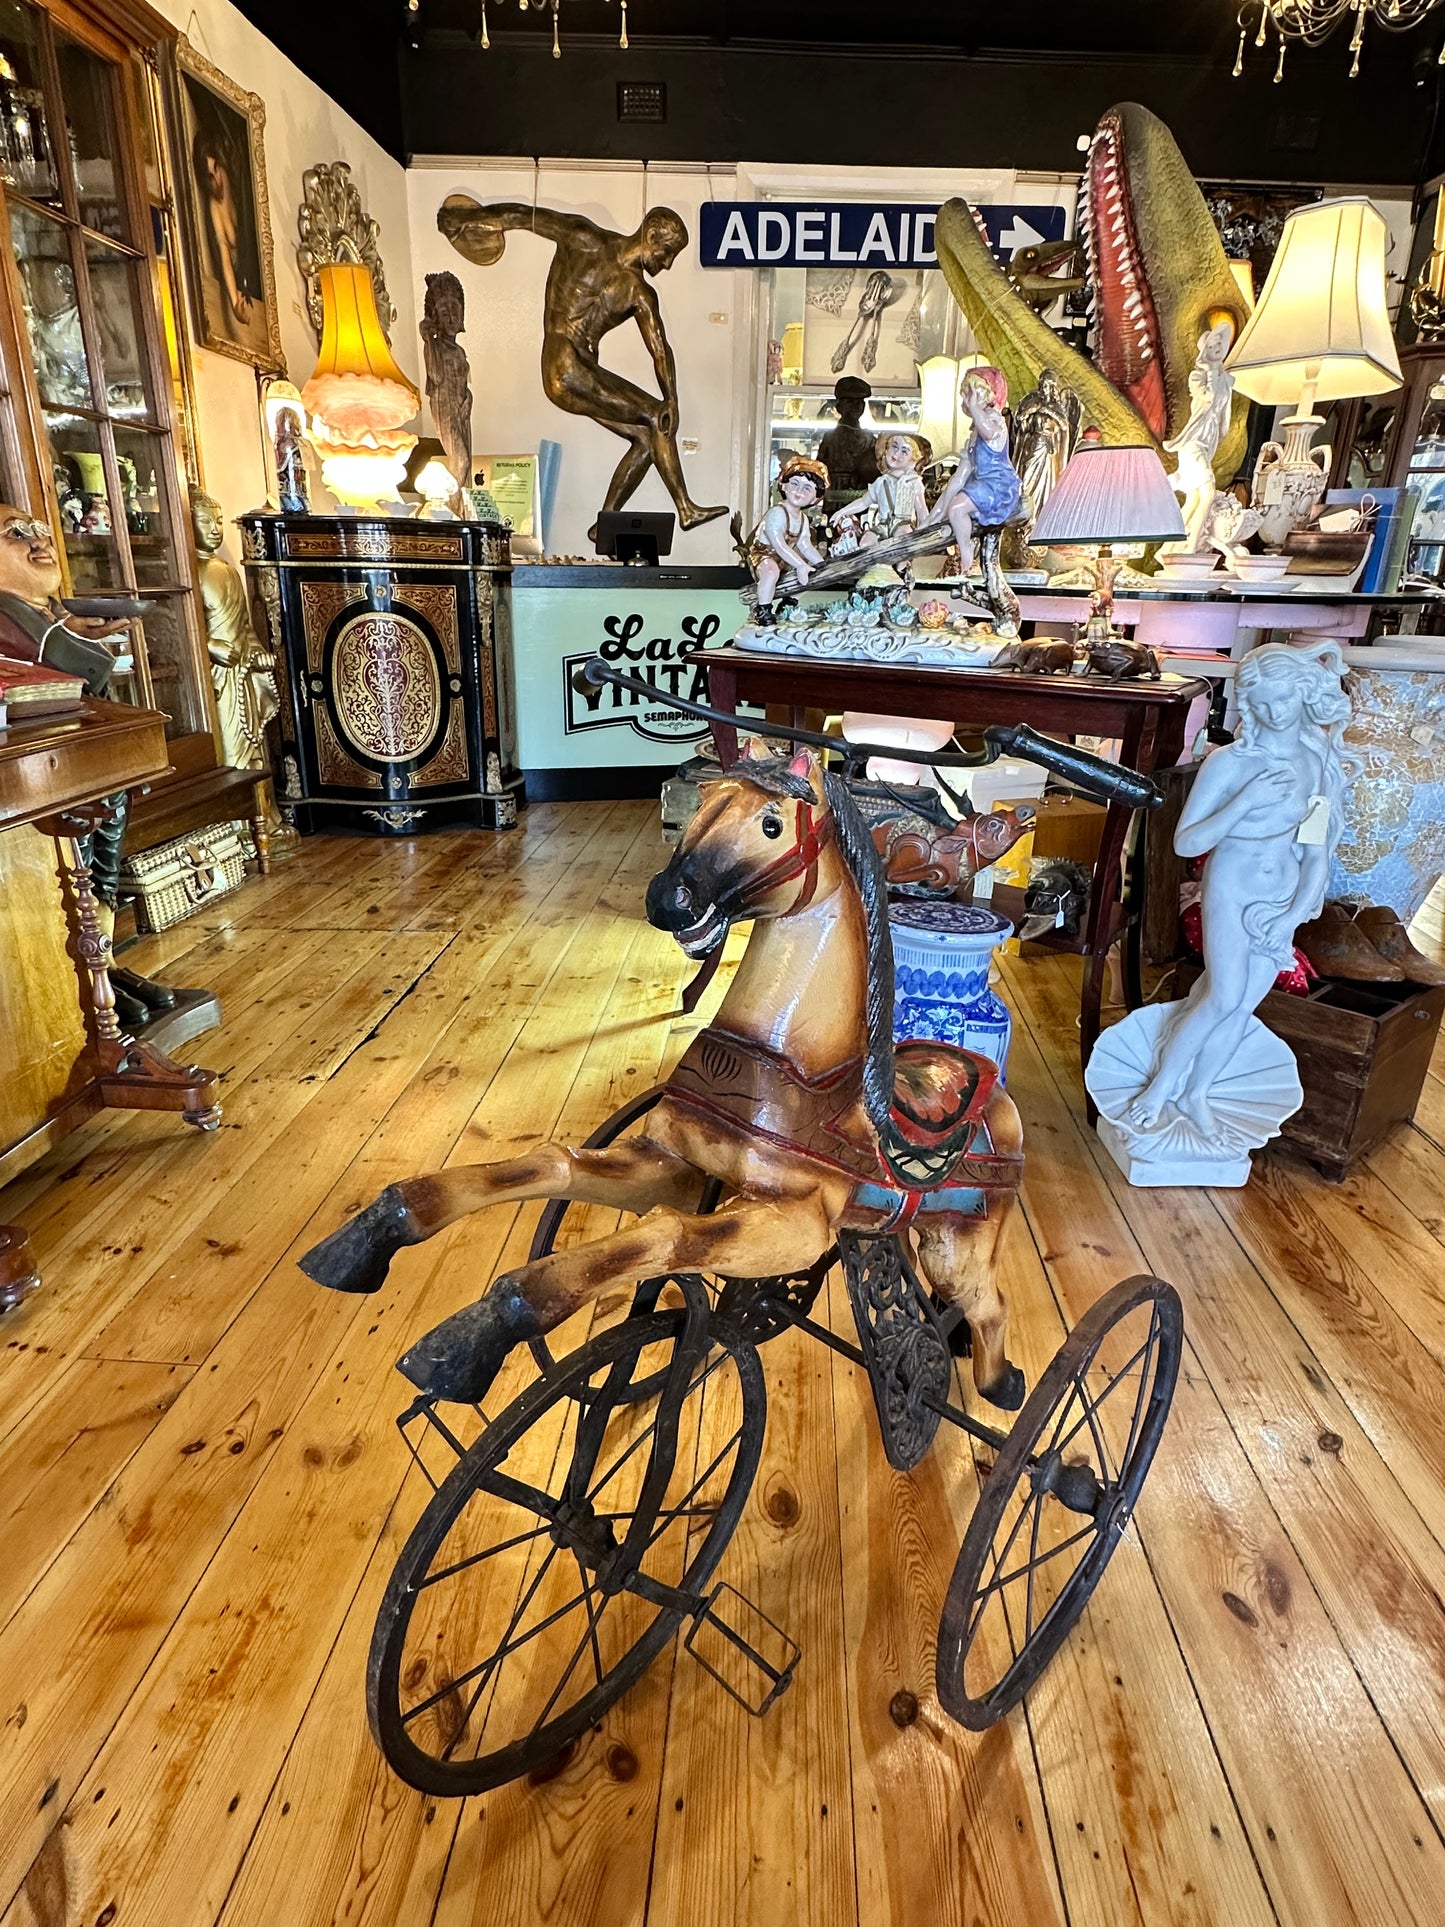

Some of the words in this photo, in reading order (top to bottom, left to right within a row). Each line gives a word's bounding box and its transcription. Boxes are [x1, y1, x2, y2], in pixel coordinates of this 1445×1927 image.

[716, 210, 938, 263] ADELAID
[600, 614, 735, 661] LaL
[644, 711, 708, 722] SEMAPHO
